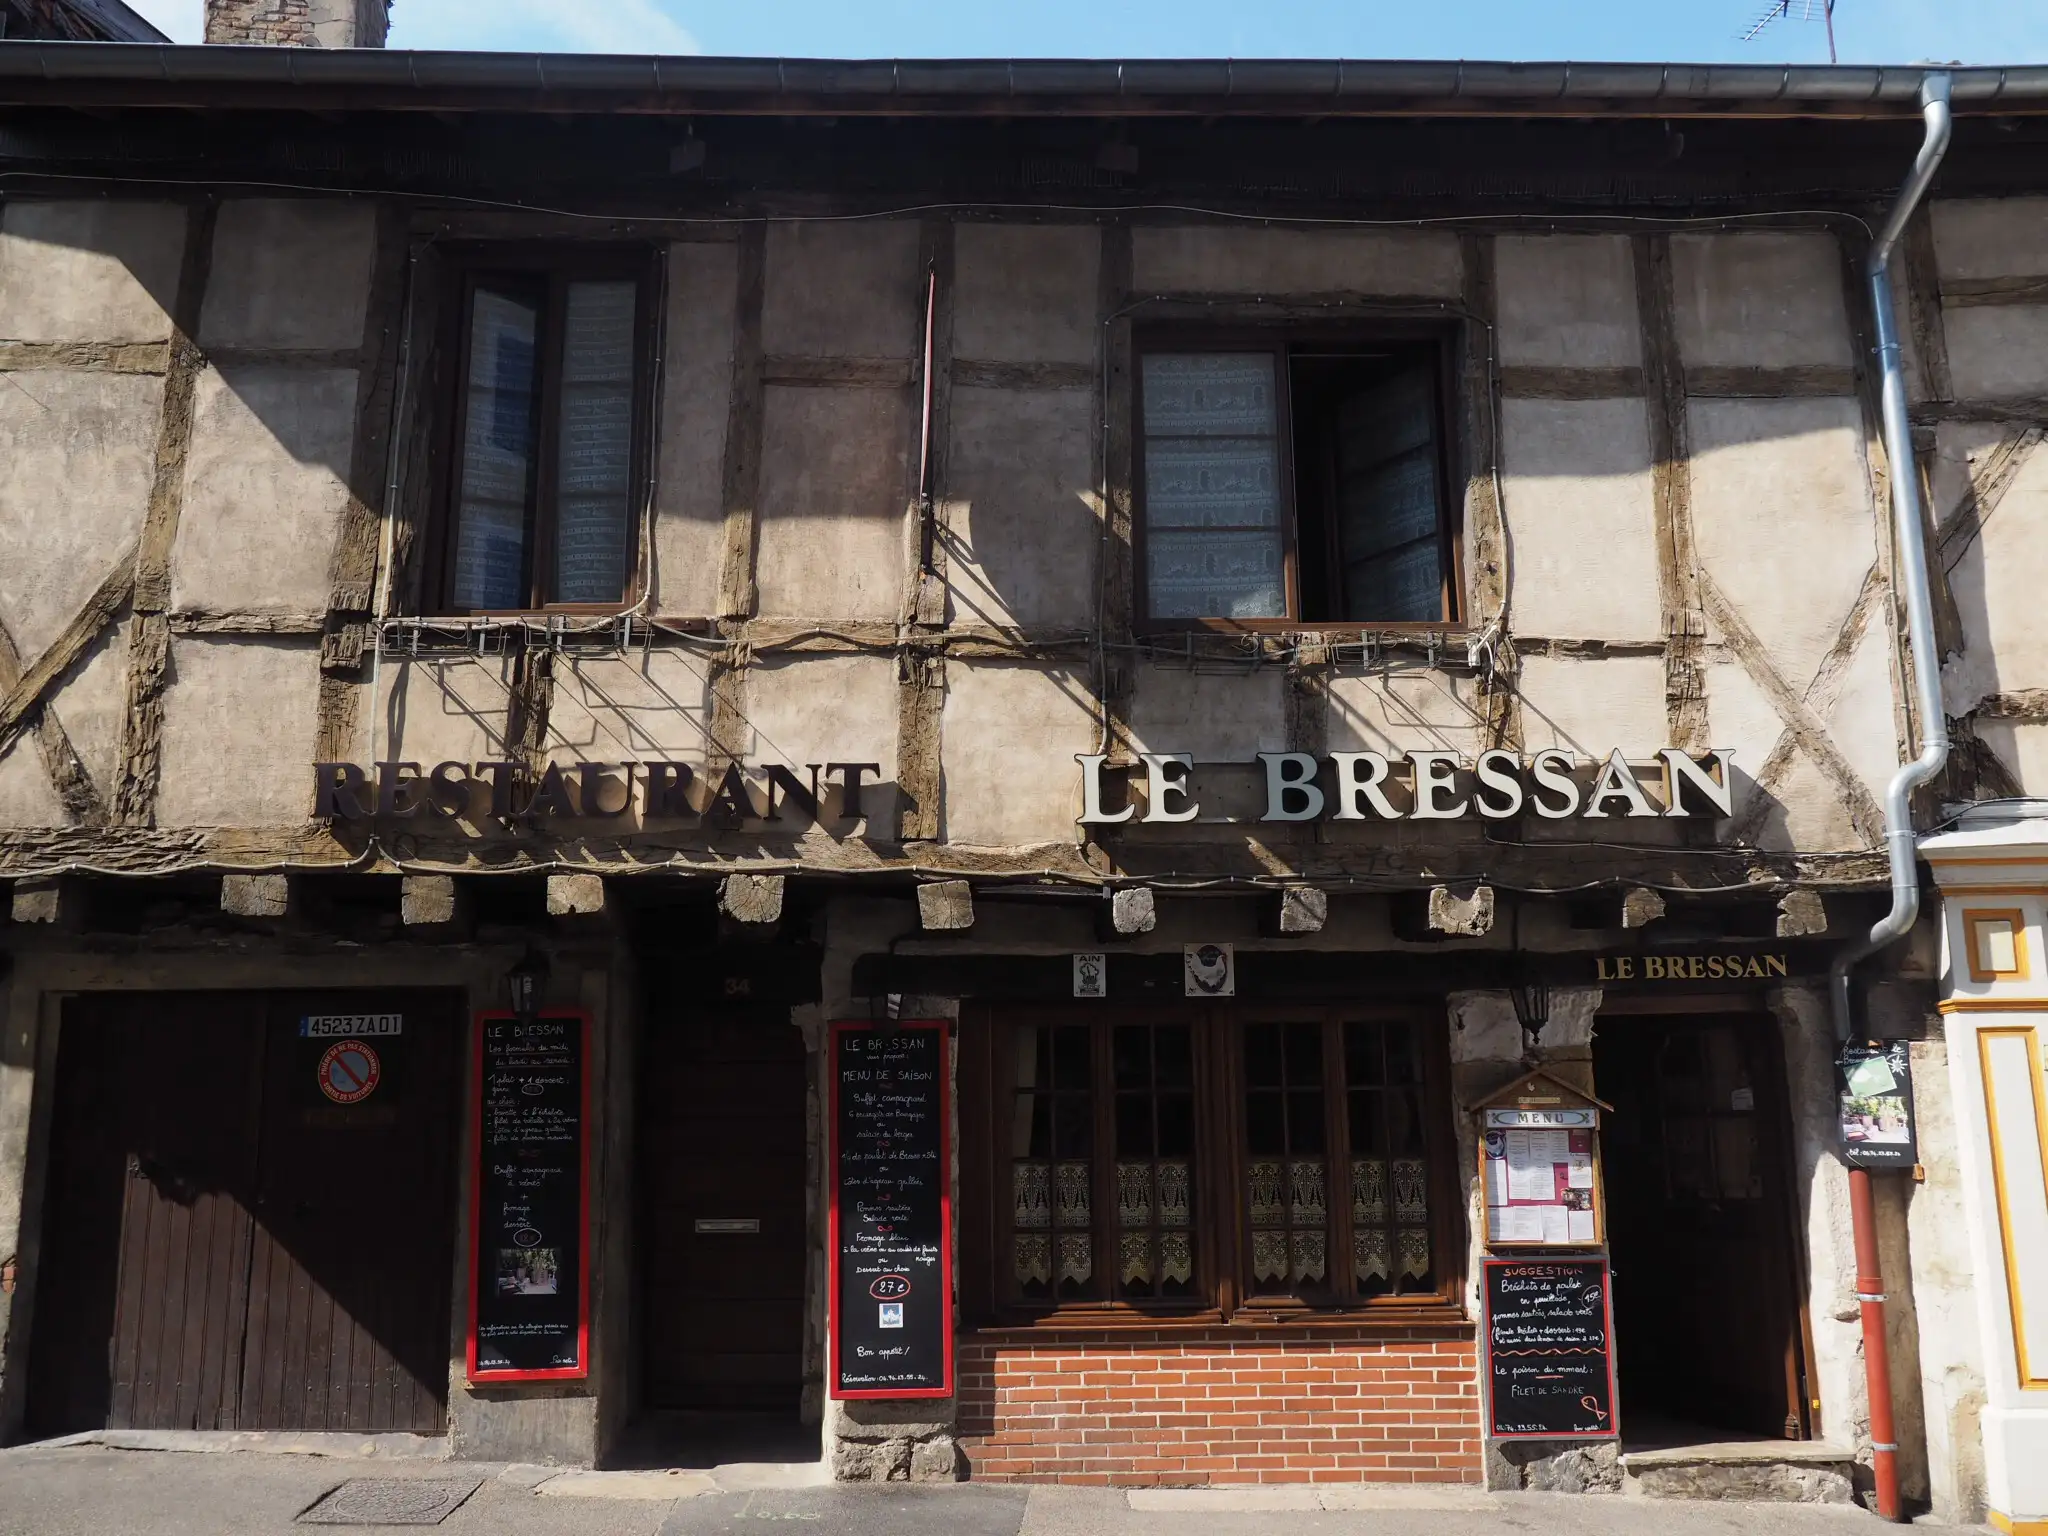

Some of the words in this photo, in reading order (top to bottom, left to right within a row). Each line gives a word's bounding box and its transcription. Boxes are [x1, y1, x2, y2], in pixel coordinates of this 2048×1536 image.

[311, 760, 881, 820] RESTAURANT
[1076, 751, 1200, 824] LE
[1257, 747, 1736, 821] BRESSAN
[1079, 955, 1101, 963] AIN
[1596, 957, 1635, 980] LE
[1643, 954, 1788, 979] BRESSAN
[725, 977, 751, 995] 34
[311, 1017, 353, 1035] 4523
[356, 1017, 376, 1033] ZA
[487, 1026, 503, 1038] LE
[845, 1039, 860, 1051] LE
[868, 1038, 925, 1050] BRSSAN
[843, 1069, 871, 1082] MENU
[876, 1070, 890, 1080] DE
[1517, 1112, 1564, 1124] MENU
[862, 1213, 887, 1223] Salade
[856, 1232, 886, 1247] Fromage
[889, 1232, 909, 1241] blanc
[1555, 1277, 1582, 1296] poulet
[1492, 1312, 1520, 1326] pommes
[1546, 1306, 1574, 1317] salade
[856, 1345, 875, 1357] Bon
[1495, 1364, 1508, 1375] Le
[1511, 1365, 1540, 1380] poisson
[1543, 1364, 1555, 1373] du
[1538, 1387, 1548, 1395] DE
[1551, 1385, 1585, 1395] SANDRE
